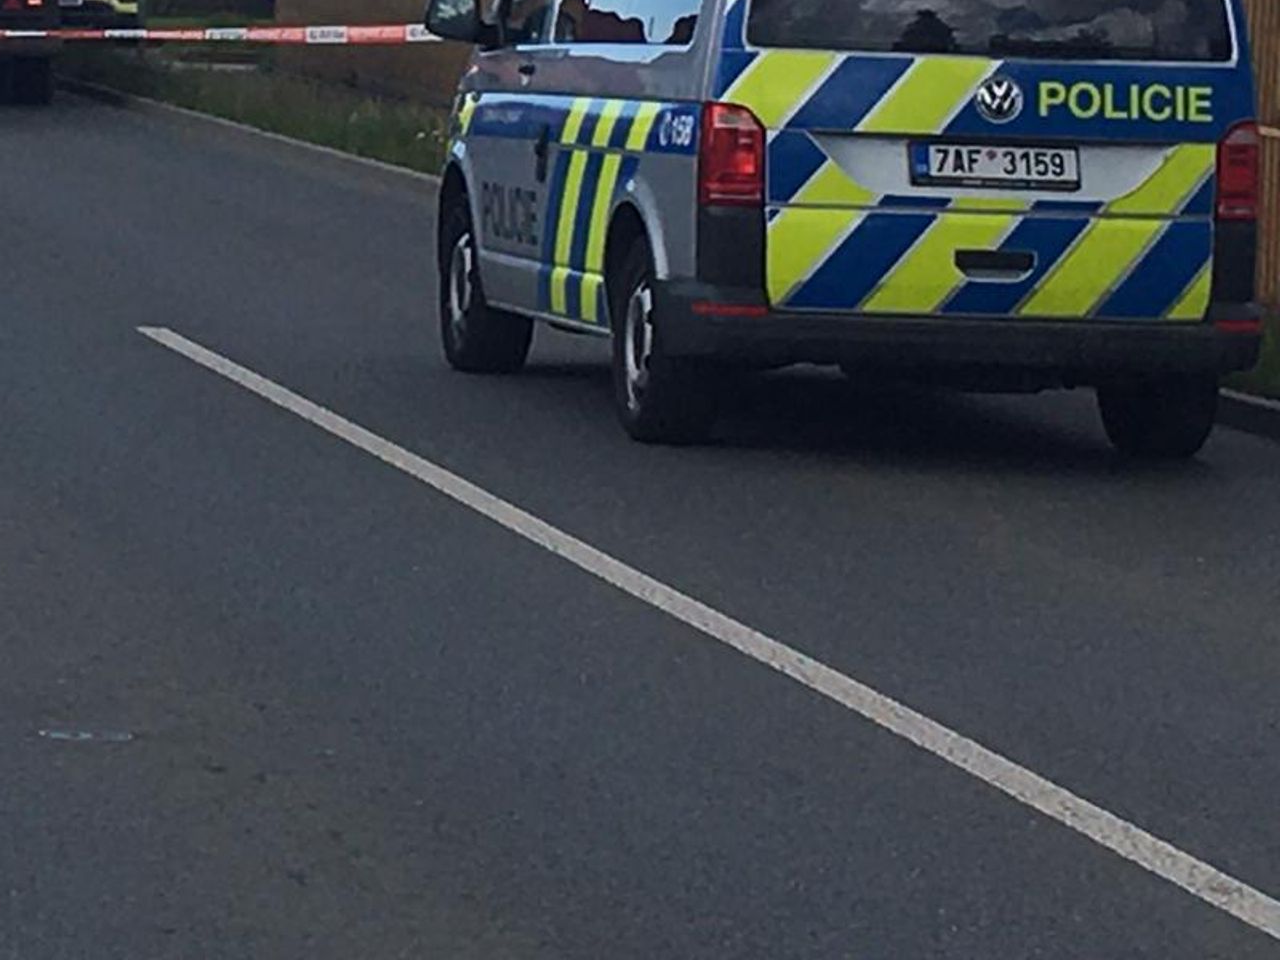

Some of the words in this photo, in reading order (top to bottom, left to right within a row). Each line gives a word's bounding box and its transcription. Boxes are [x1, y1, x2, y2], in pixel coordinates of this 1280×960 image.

[1038, 81, 1214, 123] POLICIE
[671, 114, 695, 147] 158
[934, 147, 982, 174] 7AF
[1003, 151, 1066, 177] 3159
